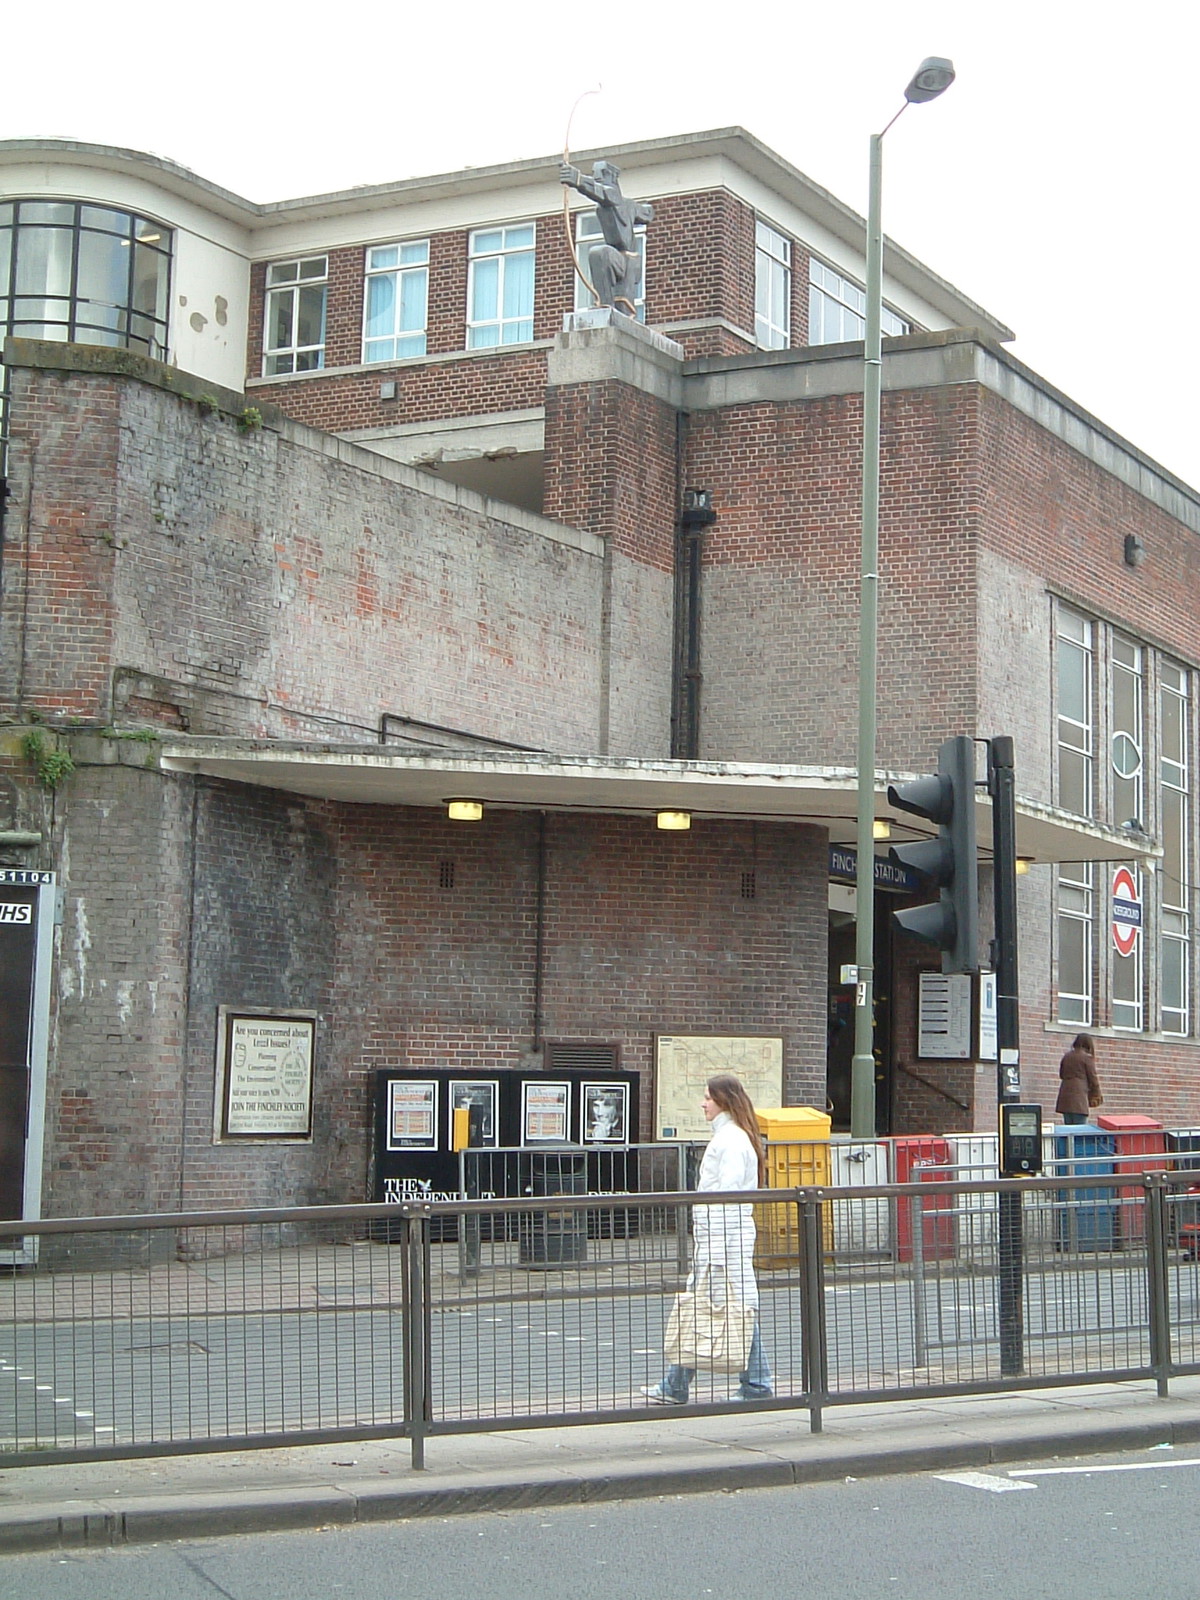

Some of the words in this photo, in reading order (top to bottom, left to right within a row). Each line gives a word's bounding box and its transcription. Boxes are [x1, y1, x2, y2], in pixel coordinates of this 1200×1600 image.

[832, 853, 858, 873] FINCH
[874, 863, 907, 884] STATION
[0, 871, 50, 883] 51104
[1113, 904, 1140, 920] NDERGROUND
[236, 1025, 246, 1035] Are
[247, 1028, 259, 1037] you
[260, 1027, 291, 1037] concerned
[292, 1028, 309, 1038] about
[237, 1074, 246, 1082] The
[231, 1101, 245, 1112] JOIN
[245, 1101, 257, 1112] THE
[257, 1102, 283, 1112] FINCHLEY
[283, 1102, 305, 1112] SOCIETY
[384, 1178, 418, 1192] THE
